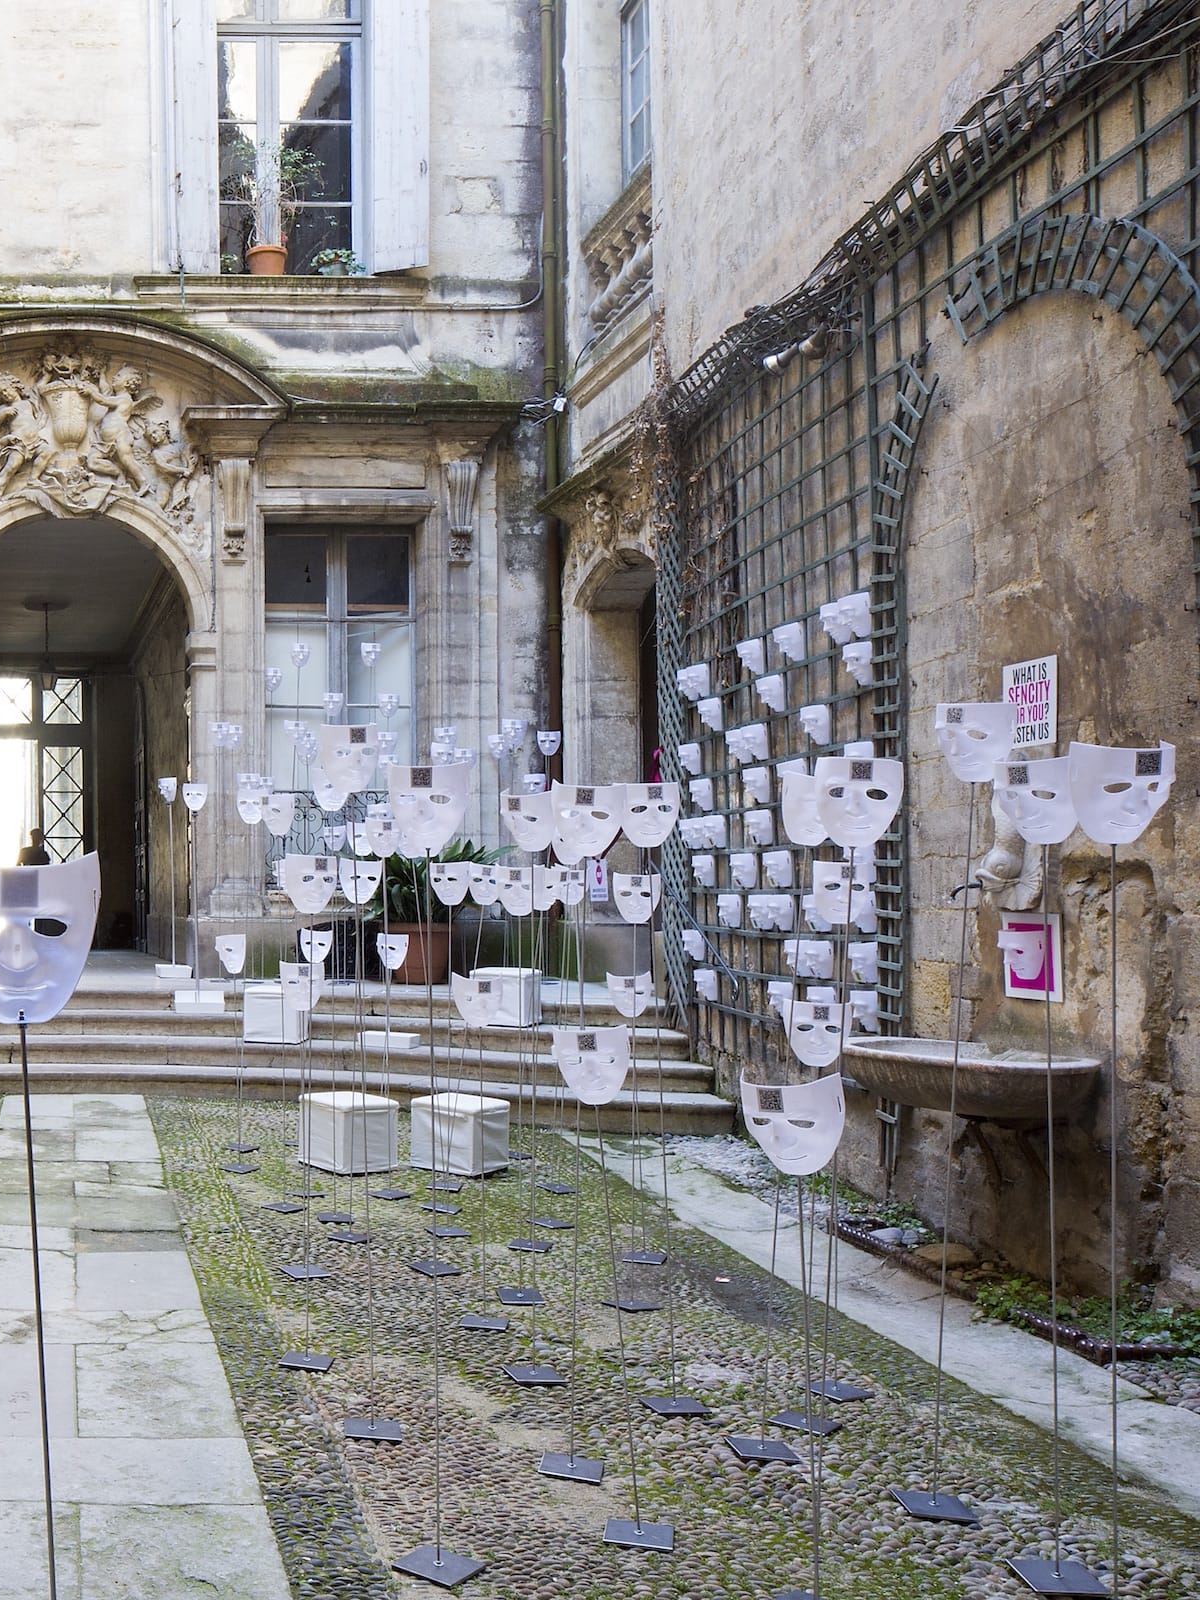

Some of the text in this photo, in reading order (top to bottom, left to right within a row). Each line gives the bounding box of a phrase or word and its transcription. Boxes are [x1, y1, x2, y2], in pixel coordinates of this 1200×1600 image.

[1012, 662, 1047, 686] WHAT IS
[1008, 679, 1051, 706] SENCITY
[1027, 702, 1050, 722] YOU?
[1038, 722, 1049, 740] US
